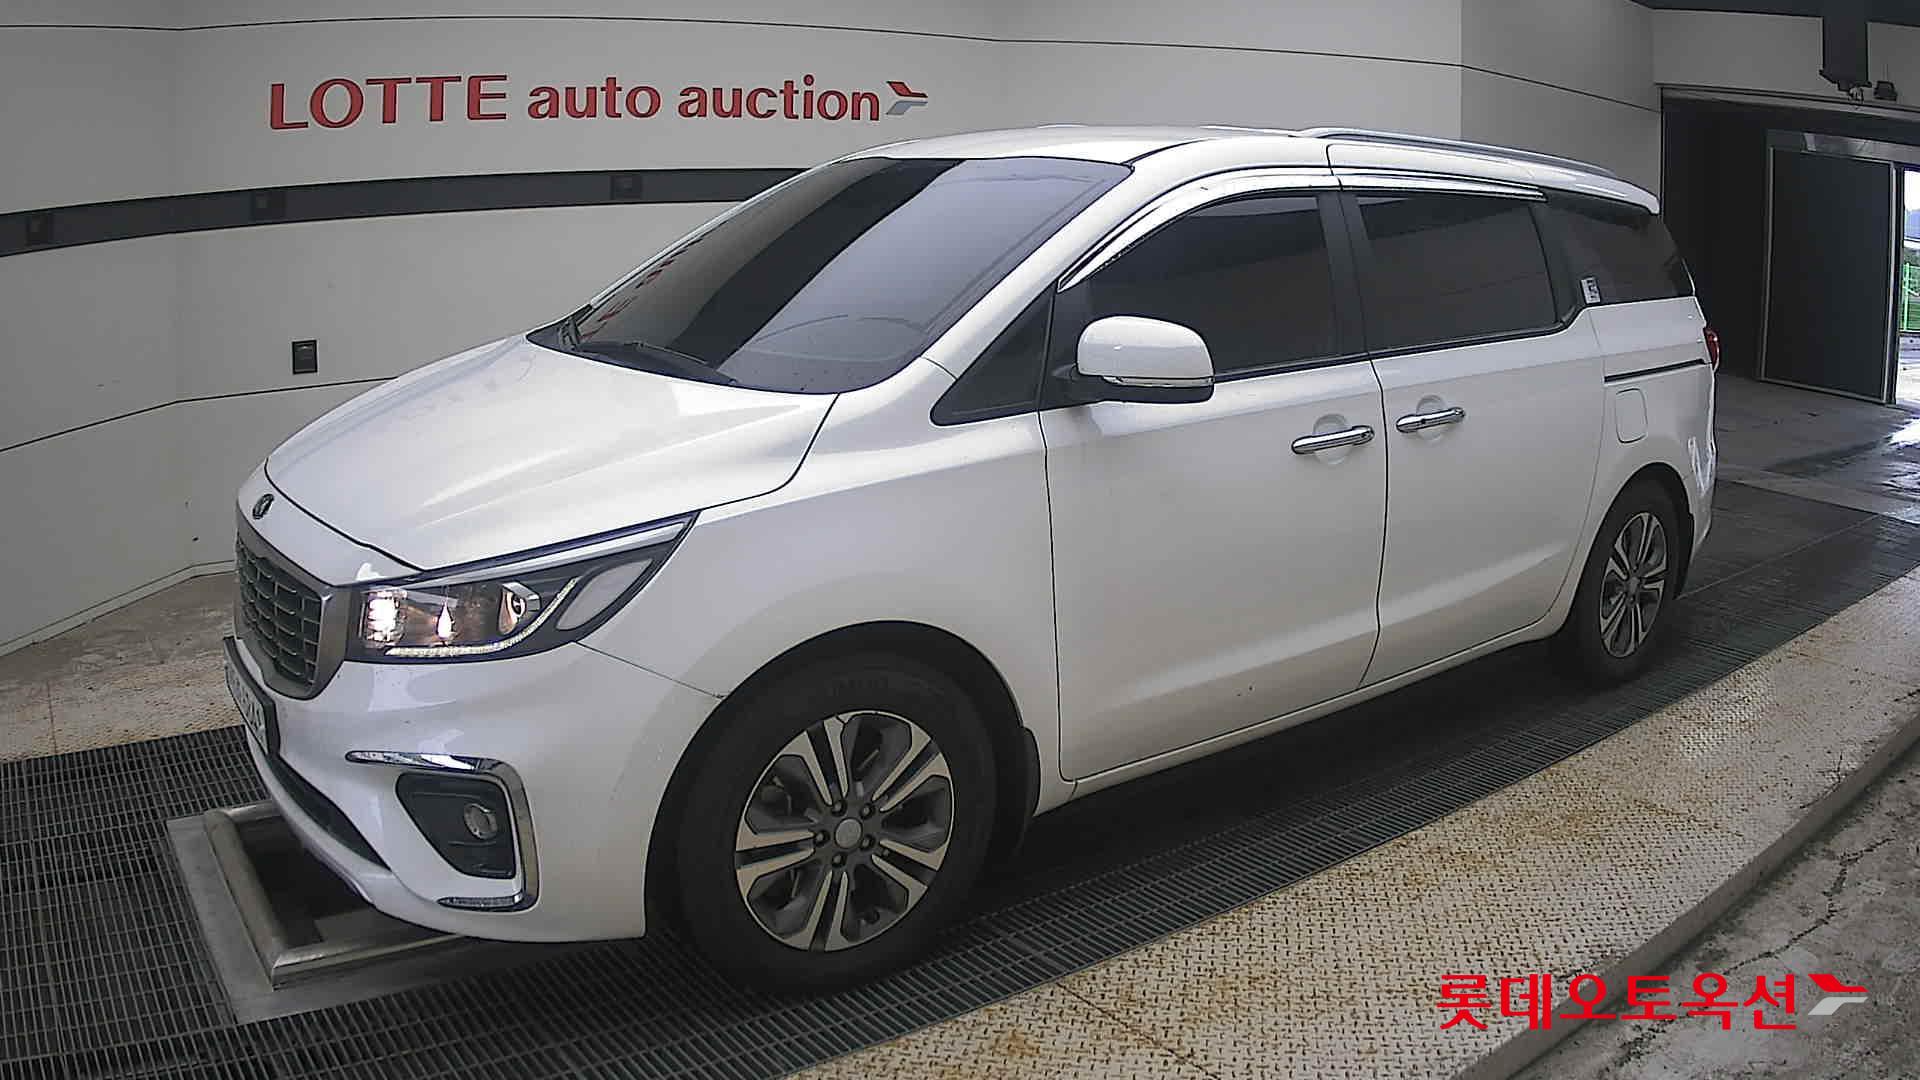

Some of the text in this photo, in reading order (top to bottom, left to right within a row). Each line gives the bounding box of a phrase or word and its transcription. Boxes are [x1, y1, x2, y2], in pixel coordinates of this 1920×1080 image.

[270, 75, 881, 129] LOTTE auto auction
